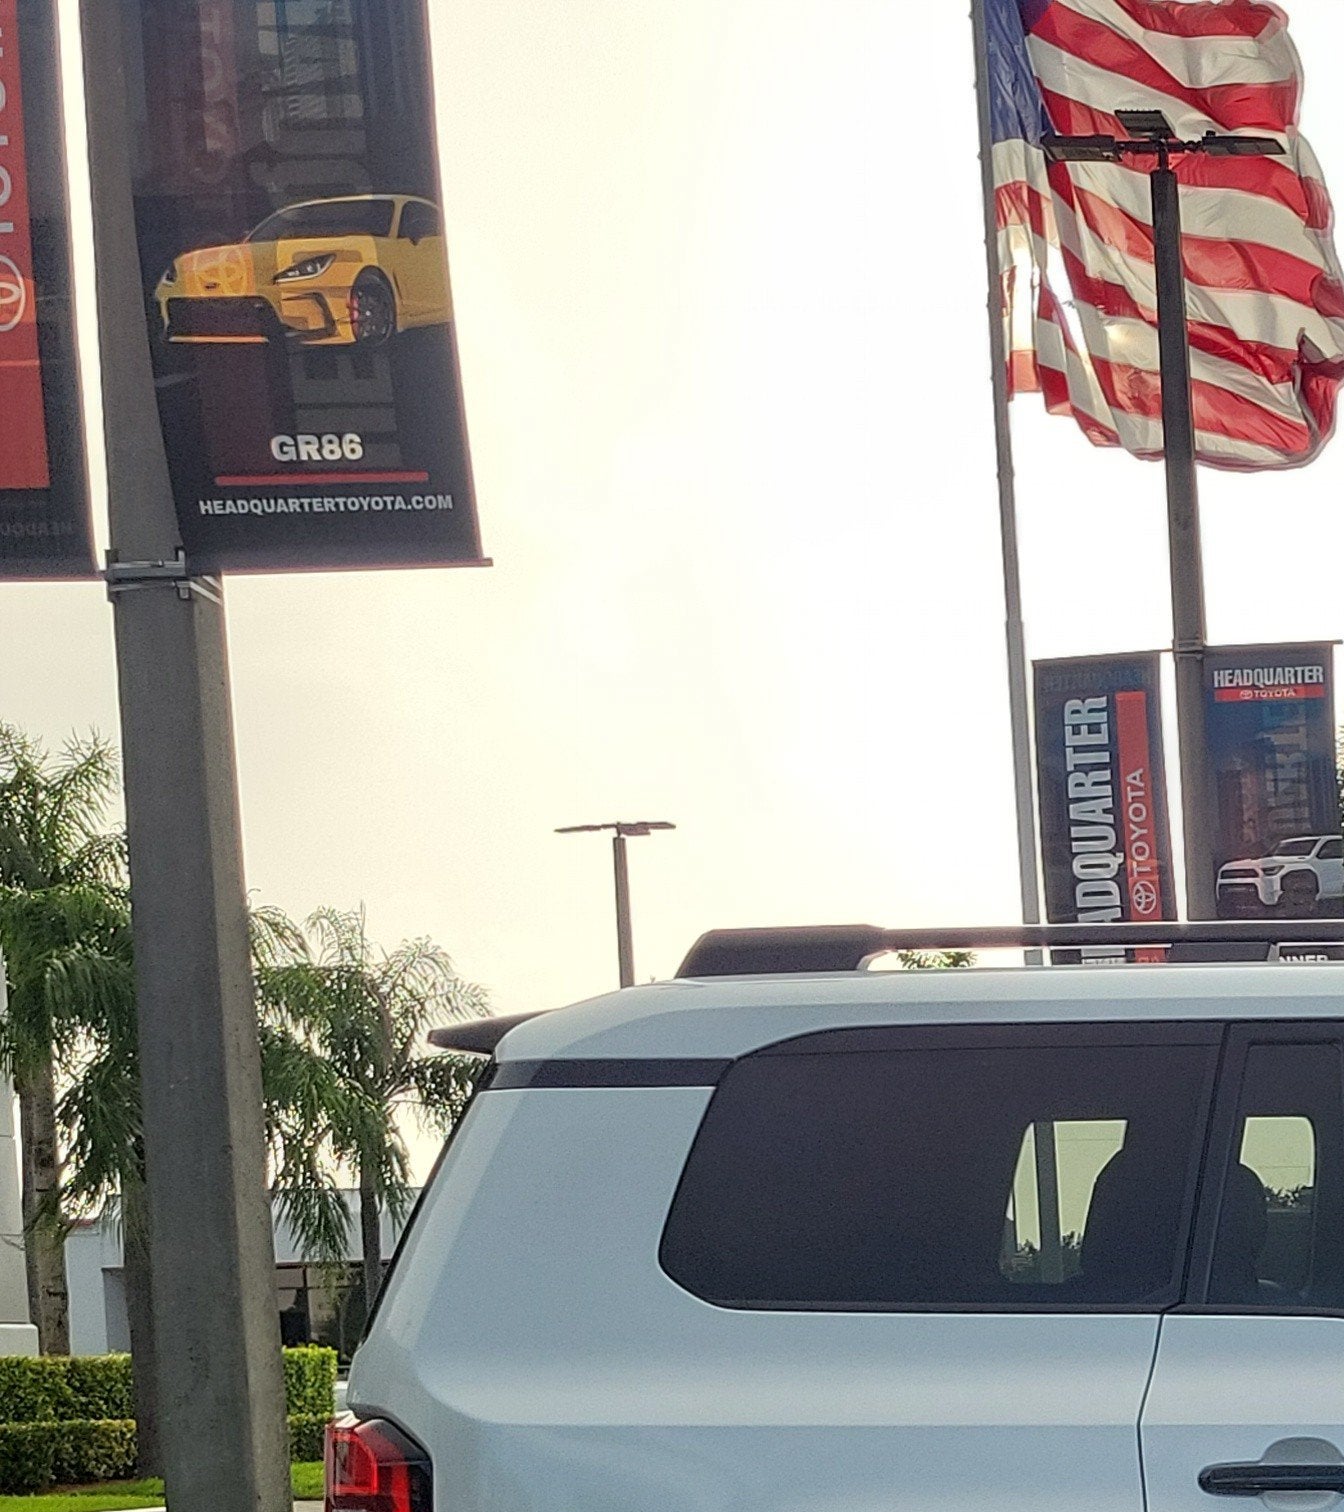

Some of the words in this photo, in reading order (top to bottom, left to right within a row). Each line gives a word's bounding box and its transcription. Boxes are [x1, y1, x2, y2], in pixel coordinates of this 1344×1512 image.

[270, 433, 363, 461] GR86
[199, 494, 453, 515] HEADQUARTERTOYOTA.COM
[1213, 665, 1324, 688] HEADQUARTER
[1253, 687, 1296, 698] TOYOTA
[1064, 695, 1124, 923] ADQUARTER
[1127, 767, 1151, 878] TOYOTA
